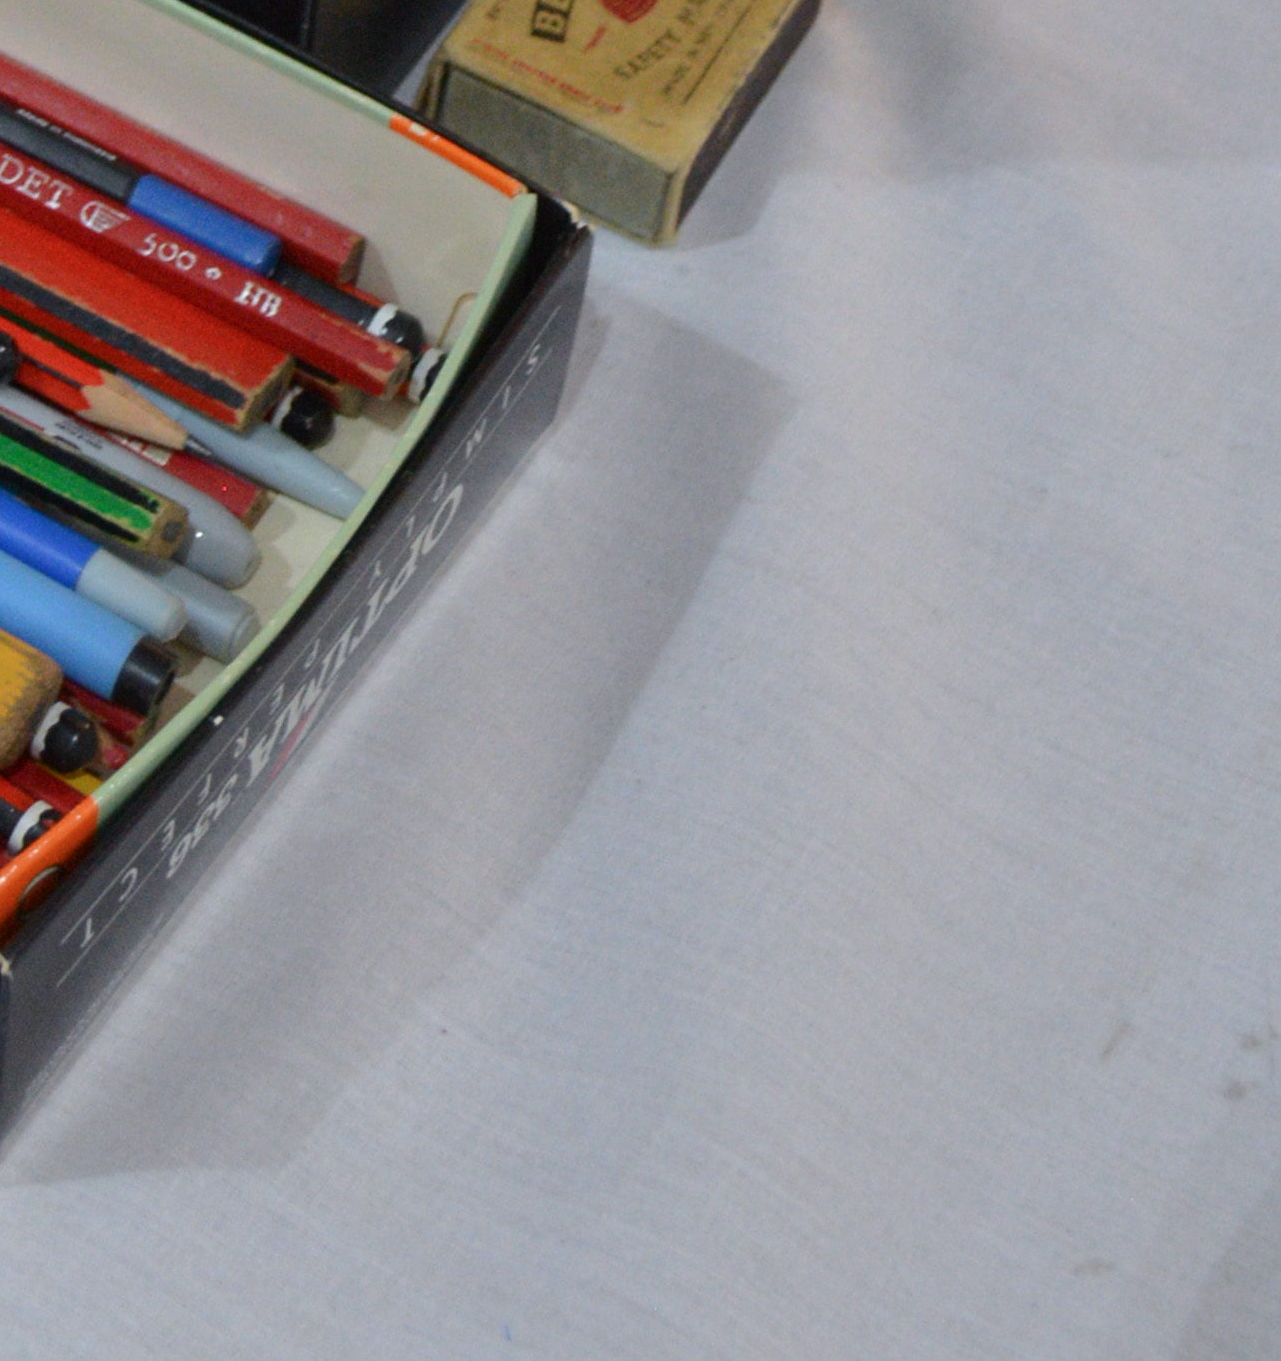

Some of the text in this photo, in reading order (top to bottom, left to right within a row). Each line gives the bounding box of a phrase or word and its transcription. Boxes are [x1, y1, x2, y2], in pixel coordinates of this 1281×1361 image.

[613, 22, 680, 81] SAFETY
[141, 229, 198, 274] 500
[234, 280, 283, 316] HB
[371, 348, 540, 577] SIMPLY
[80, 636, 323, 948] PERFECT
[166, 482, 464, 879] OPTIMA 336
